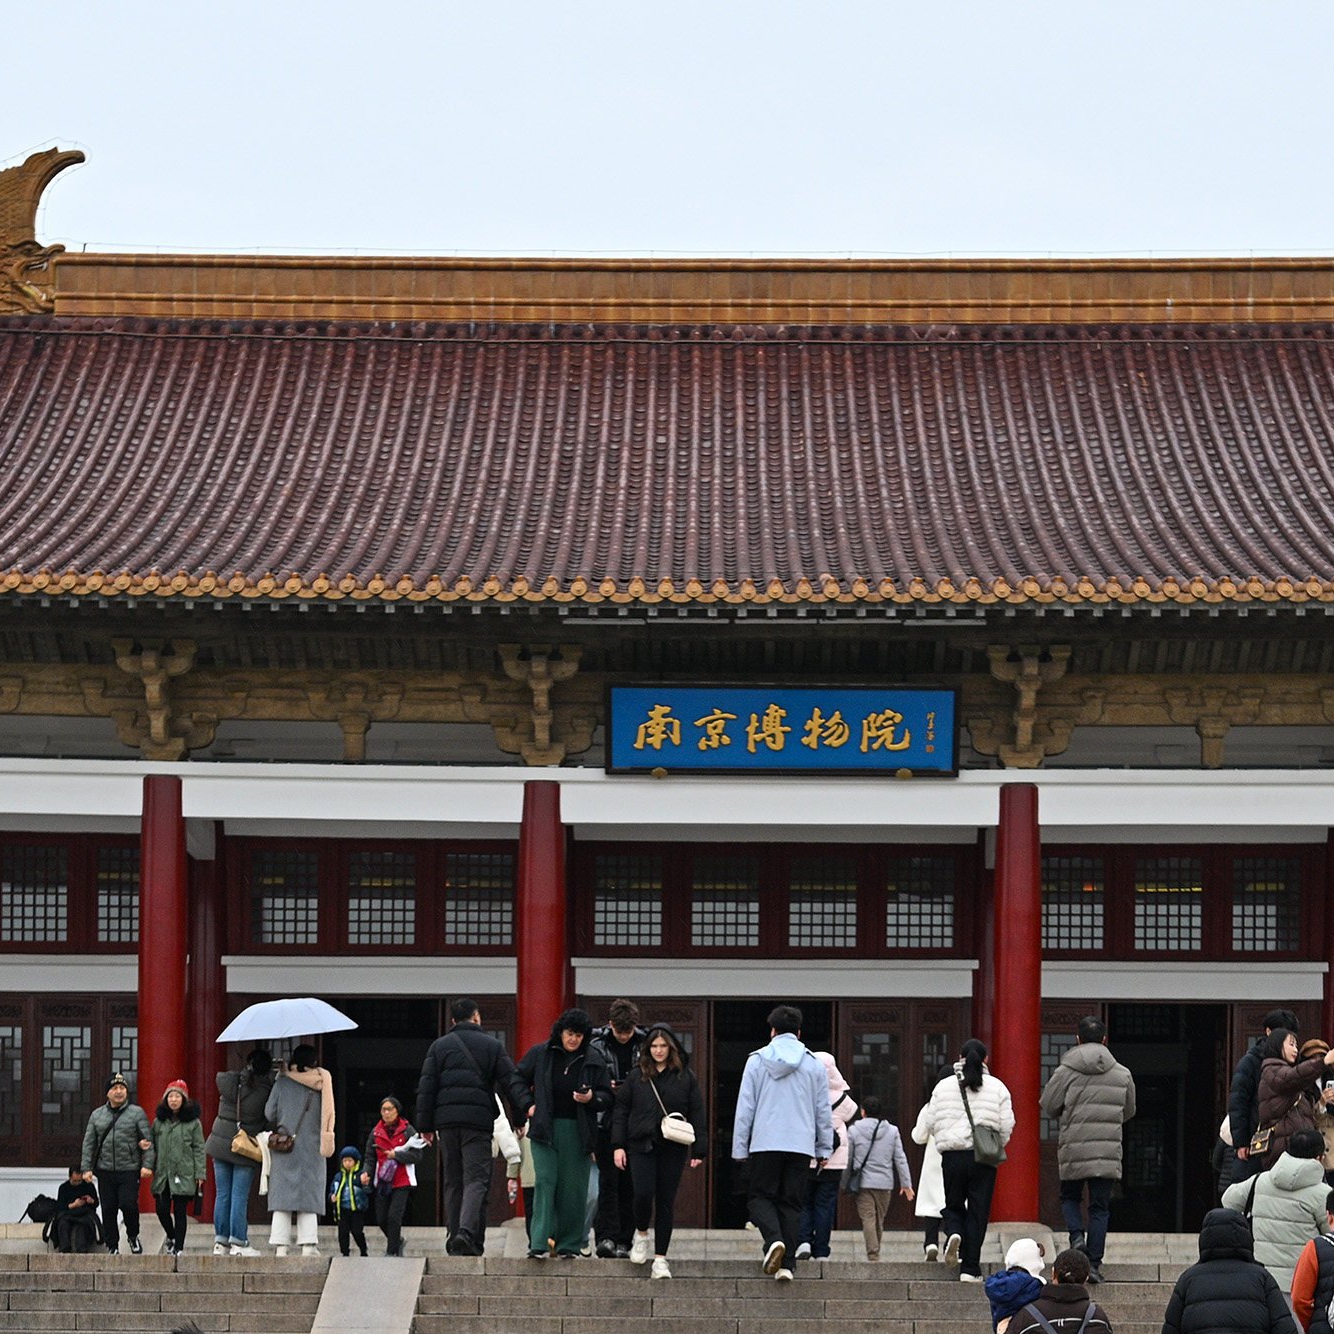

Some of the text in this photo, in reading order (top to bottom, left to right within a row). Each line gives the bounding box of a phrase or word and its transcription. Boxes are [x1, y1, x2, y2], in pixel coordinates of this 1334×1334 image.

[633, 703, 911, 753] 南京博物院
